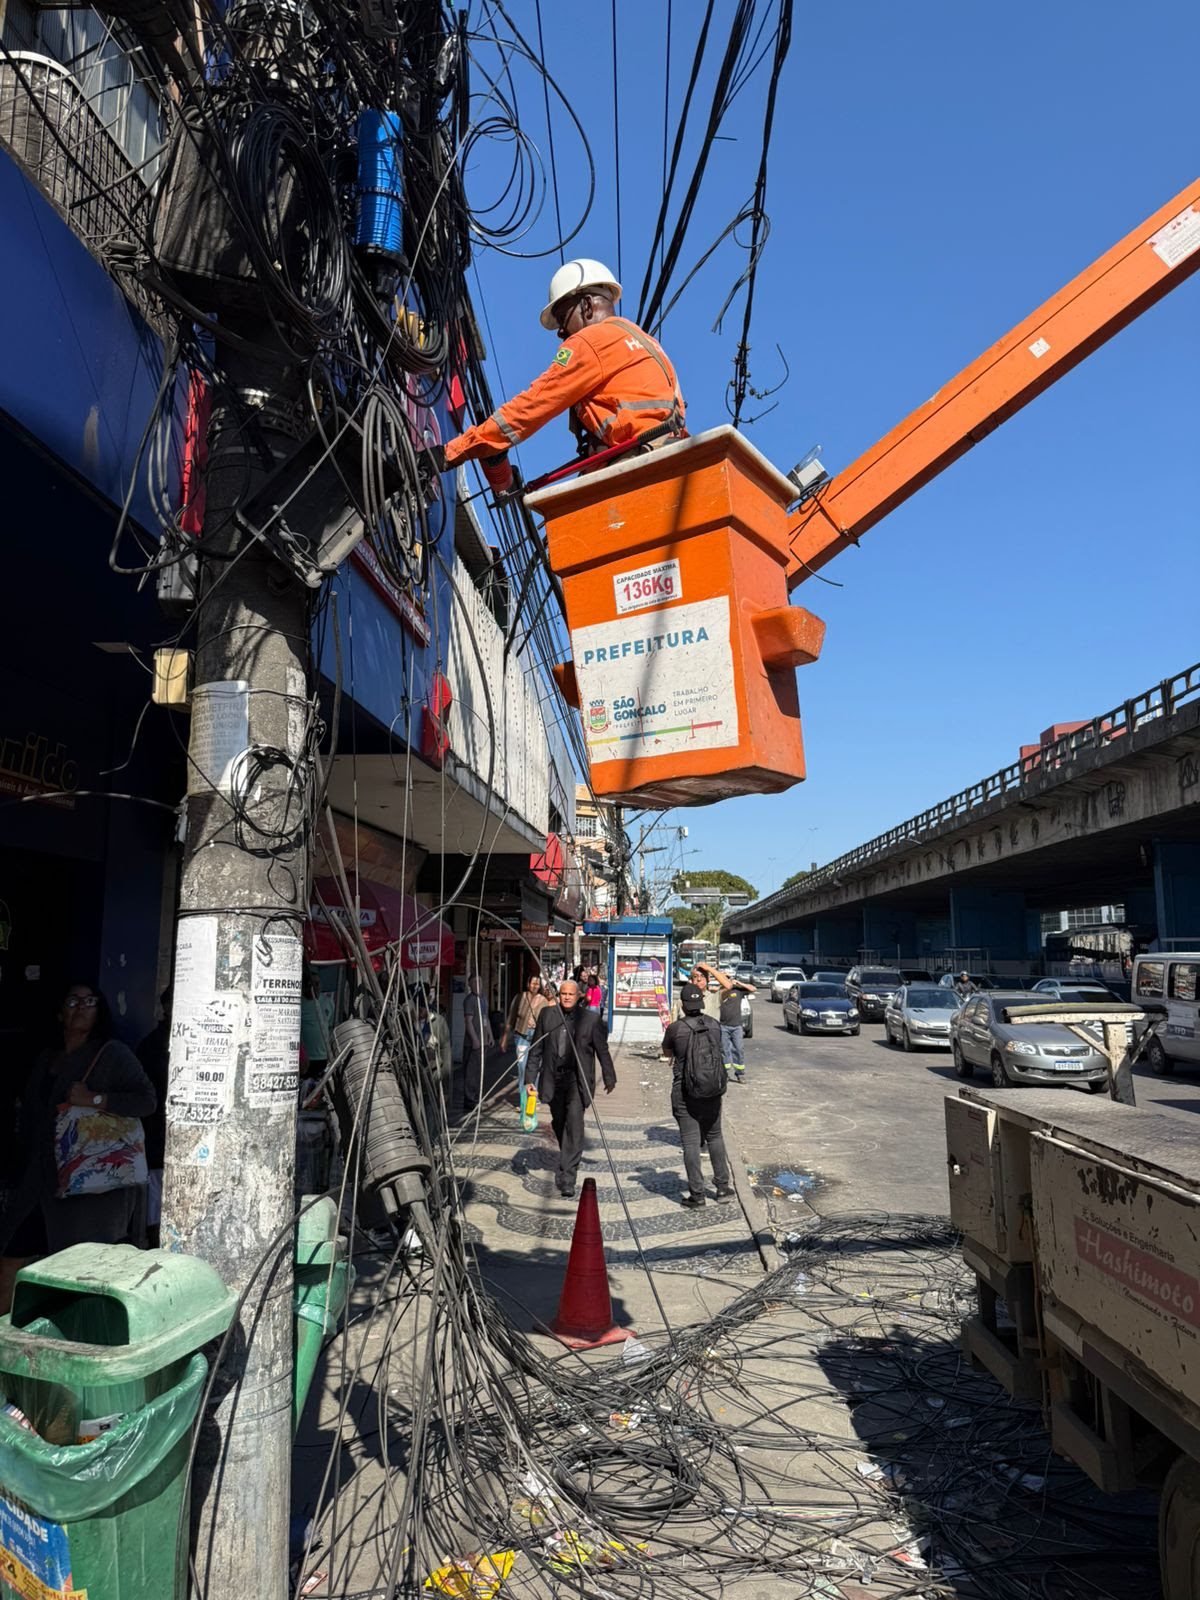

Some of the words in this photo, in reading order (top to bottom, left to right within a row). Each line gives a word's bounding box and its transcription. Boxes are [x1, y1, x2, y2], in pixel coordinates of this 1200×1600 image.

[617, 570, 652, 584] CAPACIDADE
[623, 574, 674, 601] 136Kg
[584, 626, 710, 665] PREFEITURA
[672, 686, 709, 698] TRABALHO
[613, 696, 636, 710] SÃO
[673, 699, 684, 707] EM
[684, 694, 718, 706] PRIMEIRO
[613, 703, 667, 722] GONÇALO
[674, 707, 697, 716] LUGAR
[1090, 1212, 1122, 1237] Soluções
[1129, 1232, 1175, 1263] Engenharia
[1079, 1229, 1195, 1314] Hashimoto
